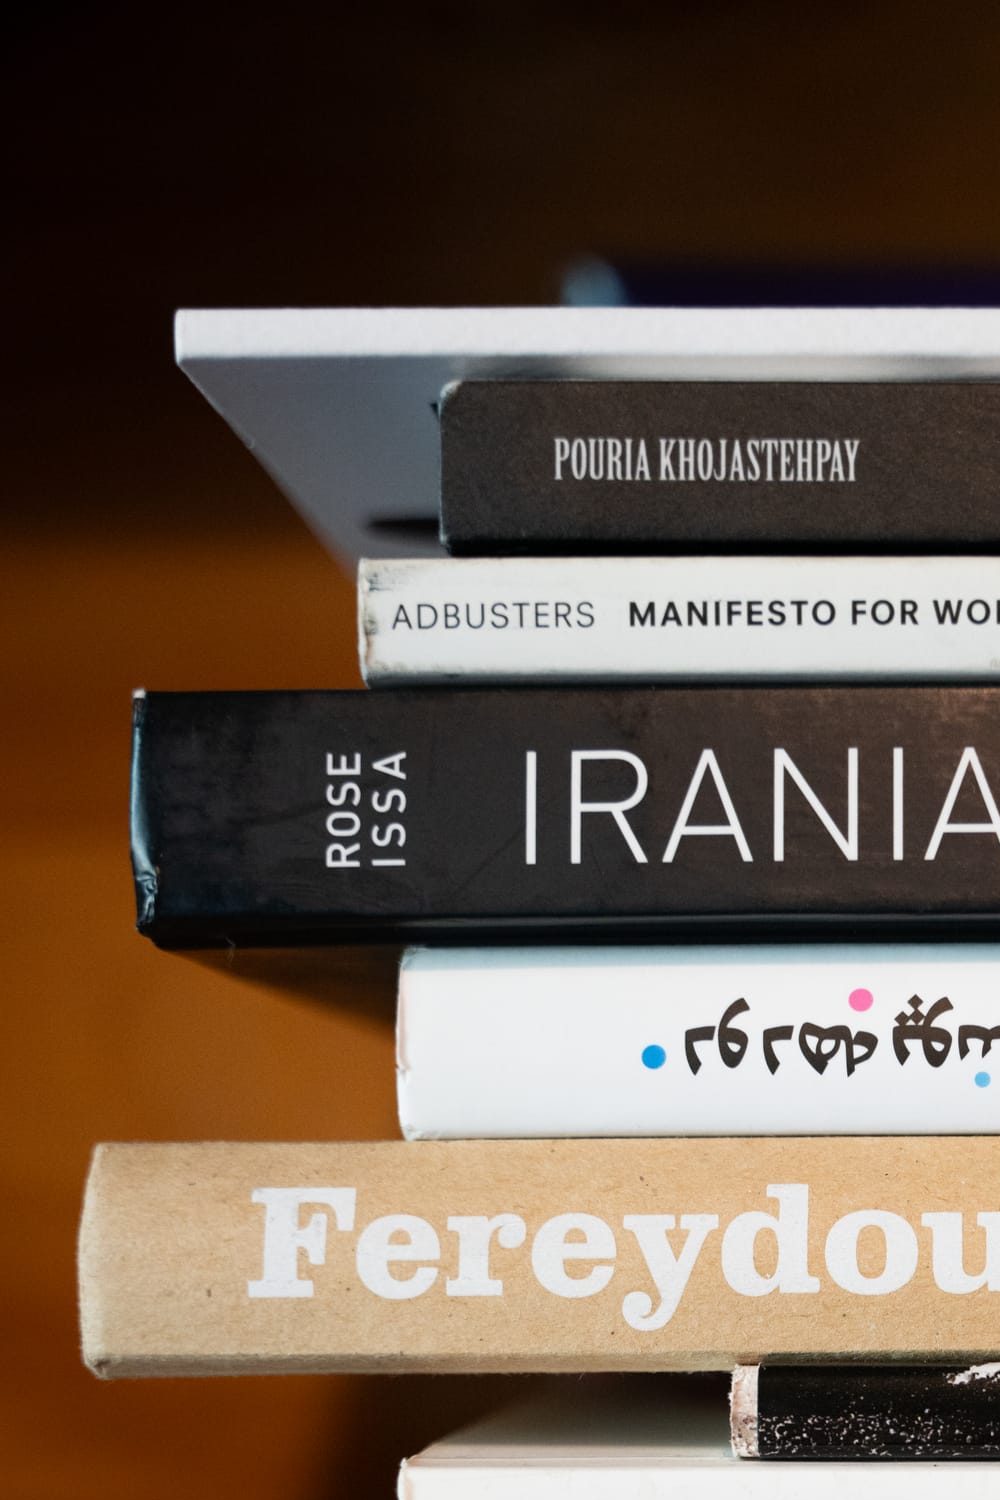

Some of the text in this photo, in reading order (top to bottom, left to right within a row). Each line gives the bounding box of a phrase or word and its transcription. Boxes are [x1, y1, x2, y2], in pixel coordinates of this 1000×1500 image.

[554, 437, 861, 483] POURIA KHOJASTEHPAY
[391, 600, 596, 630] ADBUSTERS
[629, 598, 837, 628] MANIFESTO
[852, 598, 920, 627] FOR
[325, 751, 362, 869] ROSE
[371, 751, 407, 868] ISSA
[684, 997, 751, 1077] دو
[762, 1021, 879, 1077] دهه
